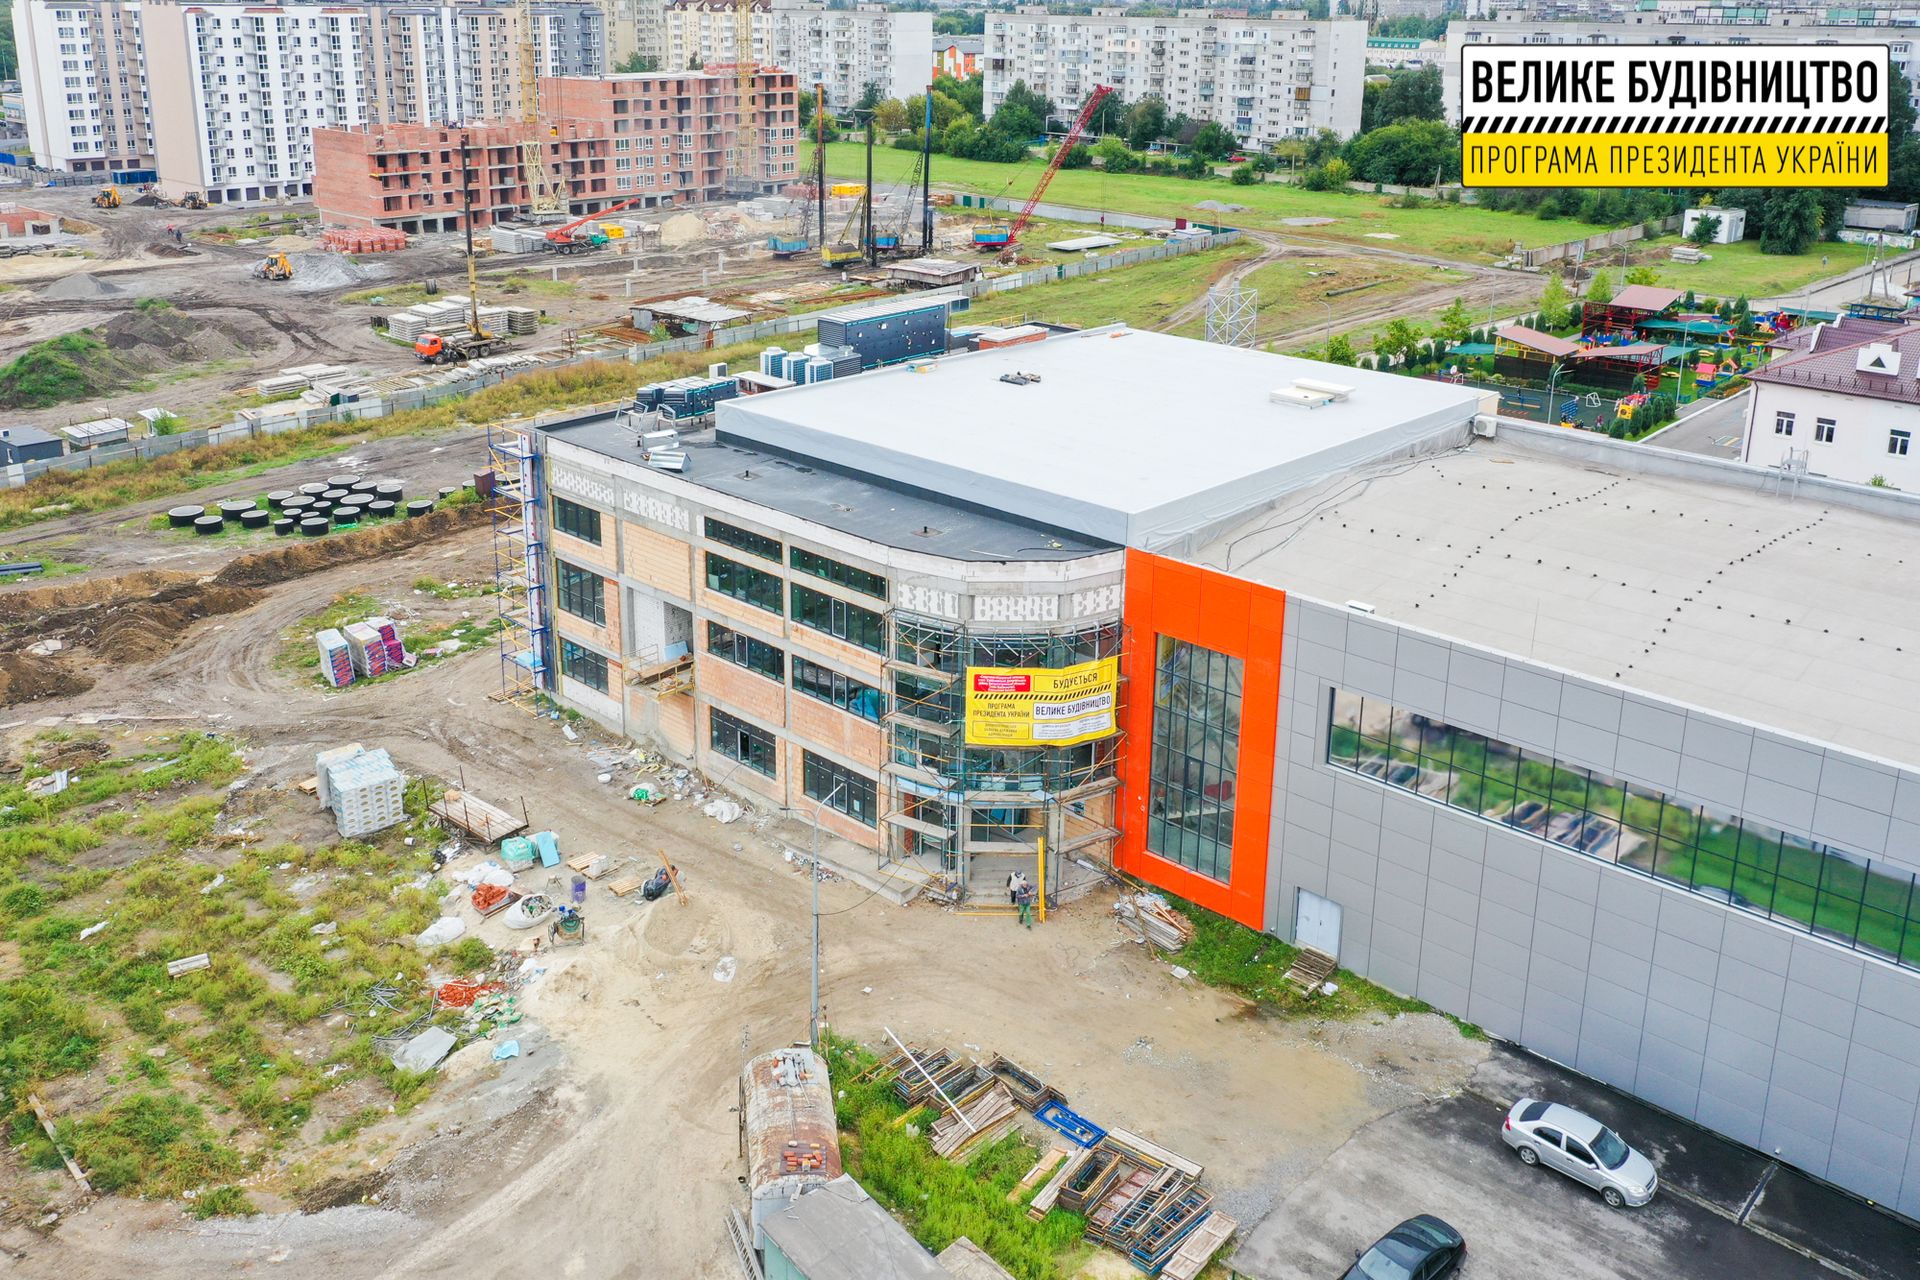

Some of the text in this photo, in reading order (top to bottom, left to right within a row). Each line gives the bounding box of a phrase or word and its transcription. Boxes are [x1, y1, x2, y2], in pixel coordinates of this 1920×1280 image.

[1053, 672, 1098, 689] БУДУЄТЬСЯ
[973, 710, 1030, 718] ПРЕЗИДЕНТА УКРАЇНИ
[1035, 695, 1111, 716] ВЕЛИКЕ БУДІВНИЦТВО
